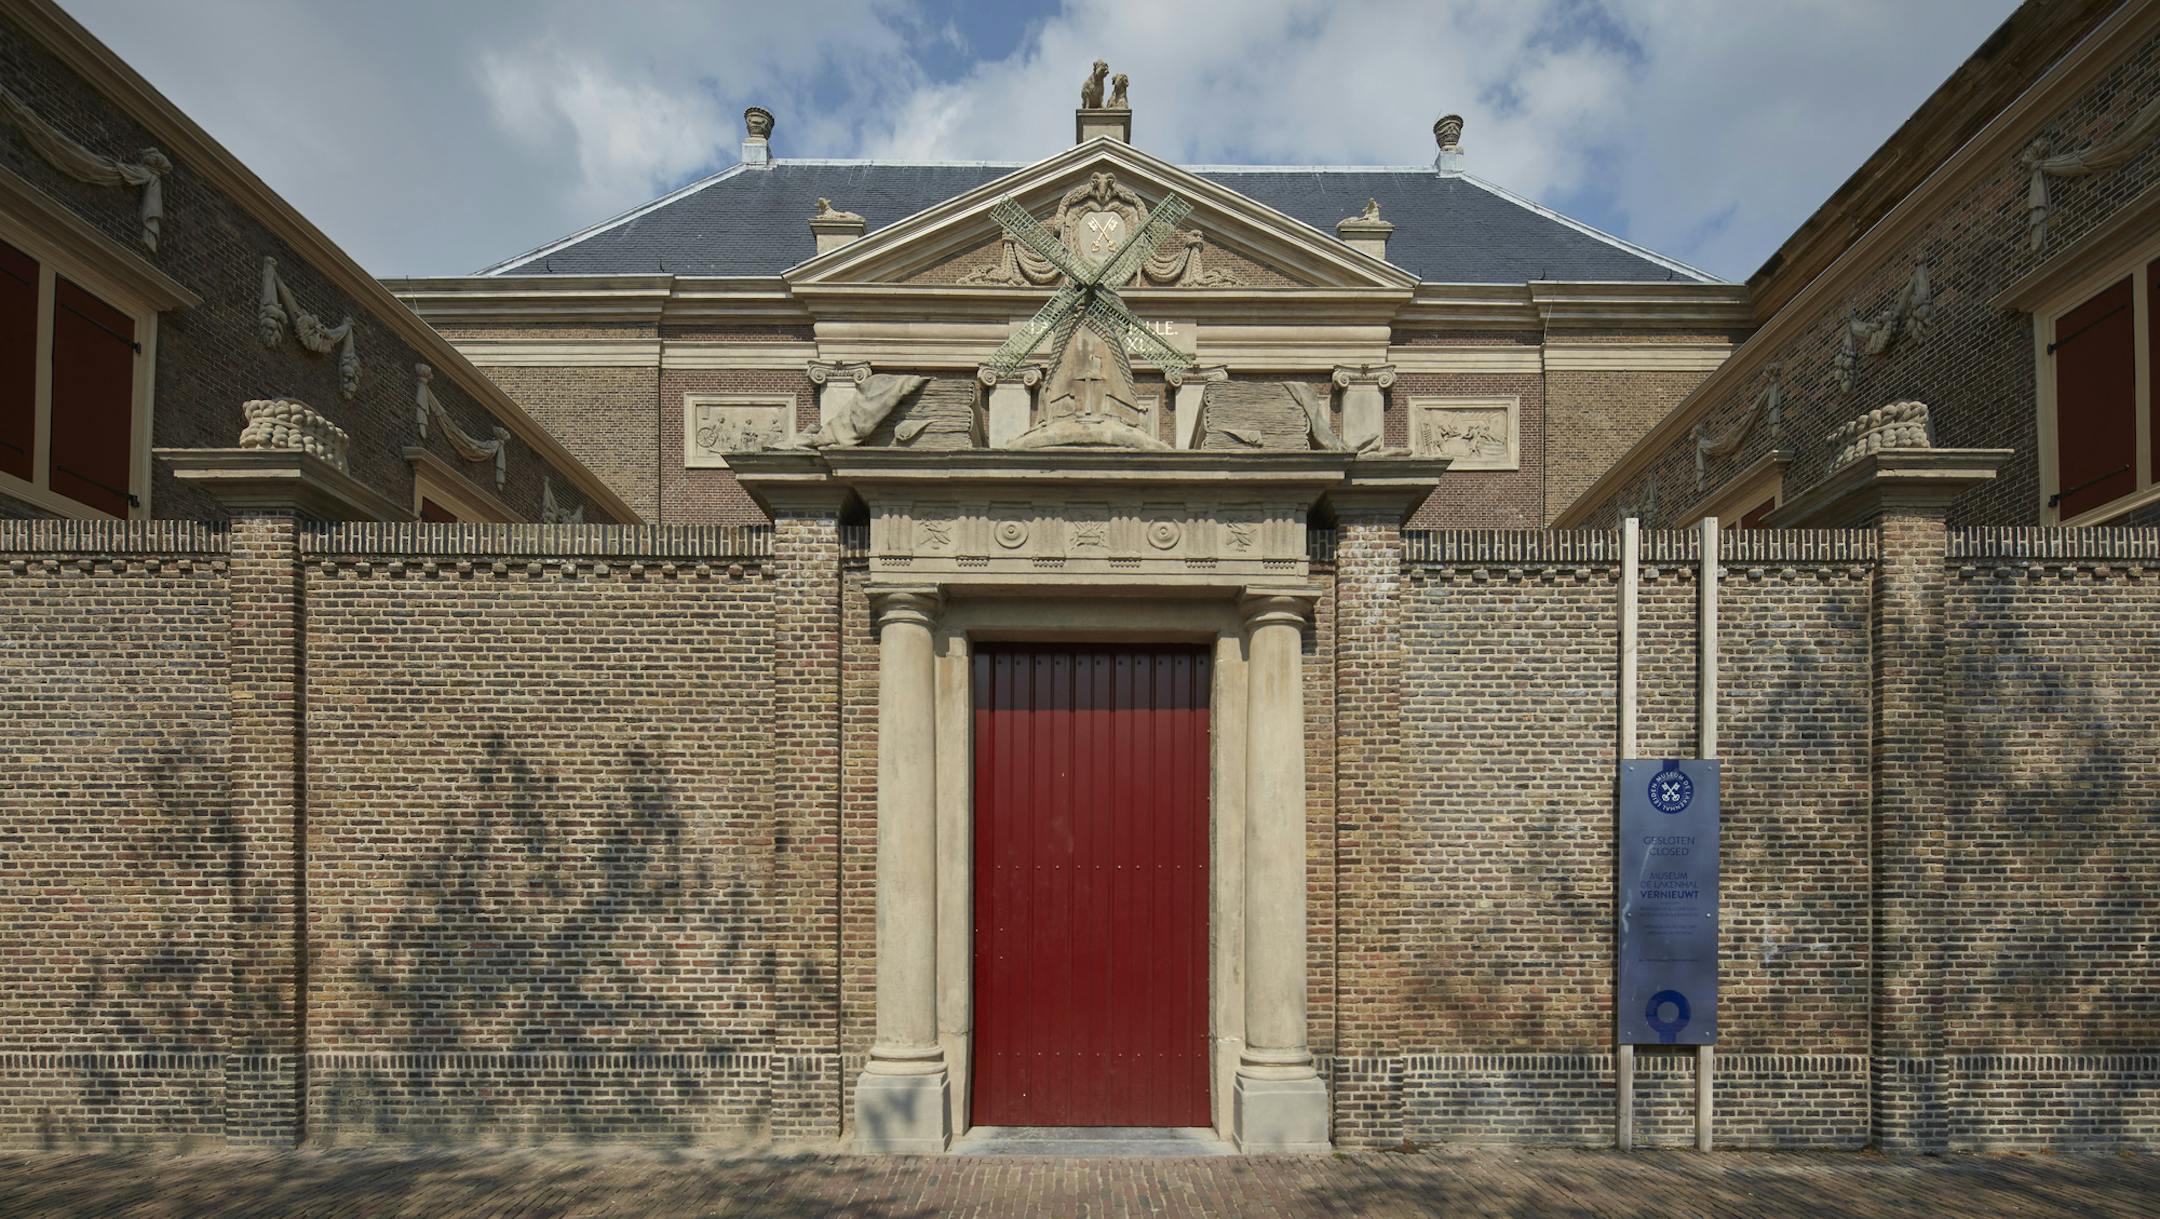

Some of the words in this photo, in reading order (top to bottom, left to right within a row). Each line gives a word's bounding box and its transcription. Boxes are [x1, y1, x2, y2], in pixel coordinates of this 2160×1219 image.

[1656, 771, 1685, 782] MUSEUM
[1651, 783, 1662, 808] LEIDEN
[1662, 791, 1691, 812] LAKENHAL
[1643, 836, 1696, 846] GESLOTEN
[1649, 847, 1689, 857] CLOSED
[1649, 871, 1688, 881] MUSEUM
[1640, 880, 1653, 890] DE
[1654, 880, 1699, 890] LAKENHAL
[1640, 890, 1699, 900] VERNIEUWT
